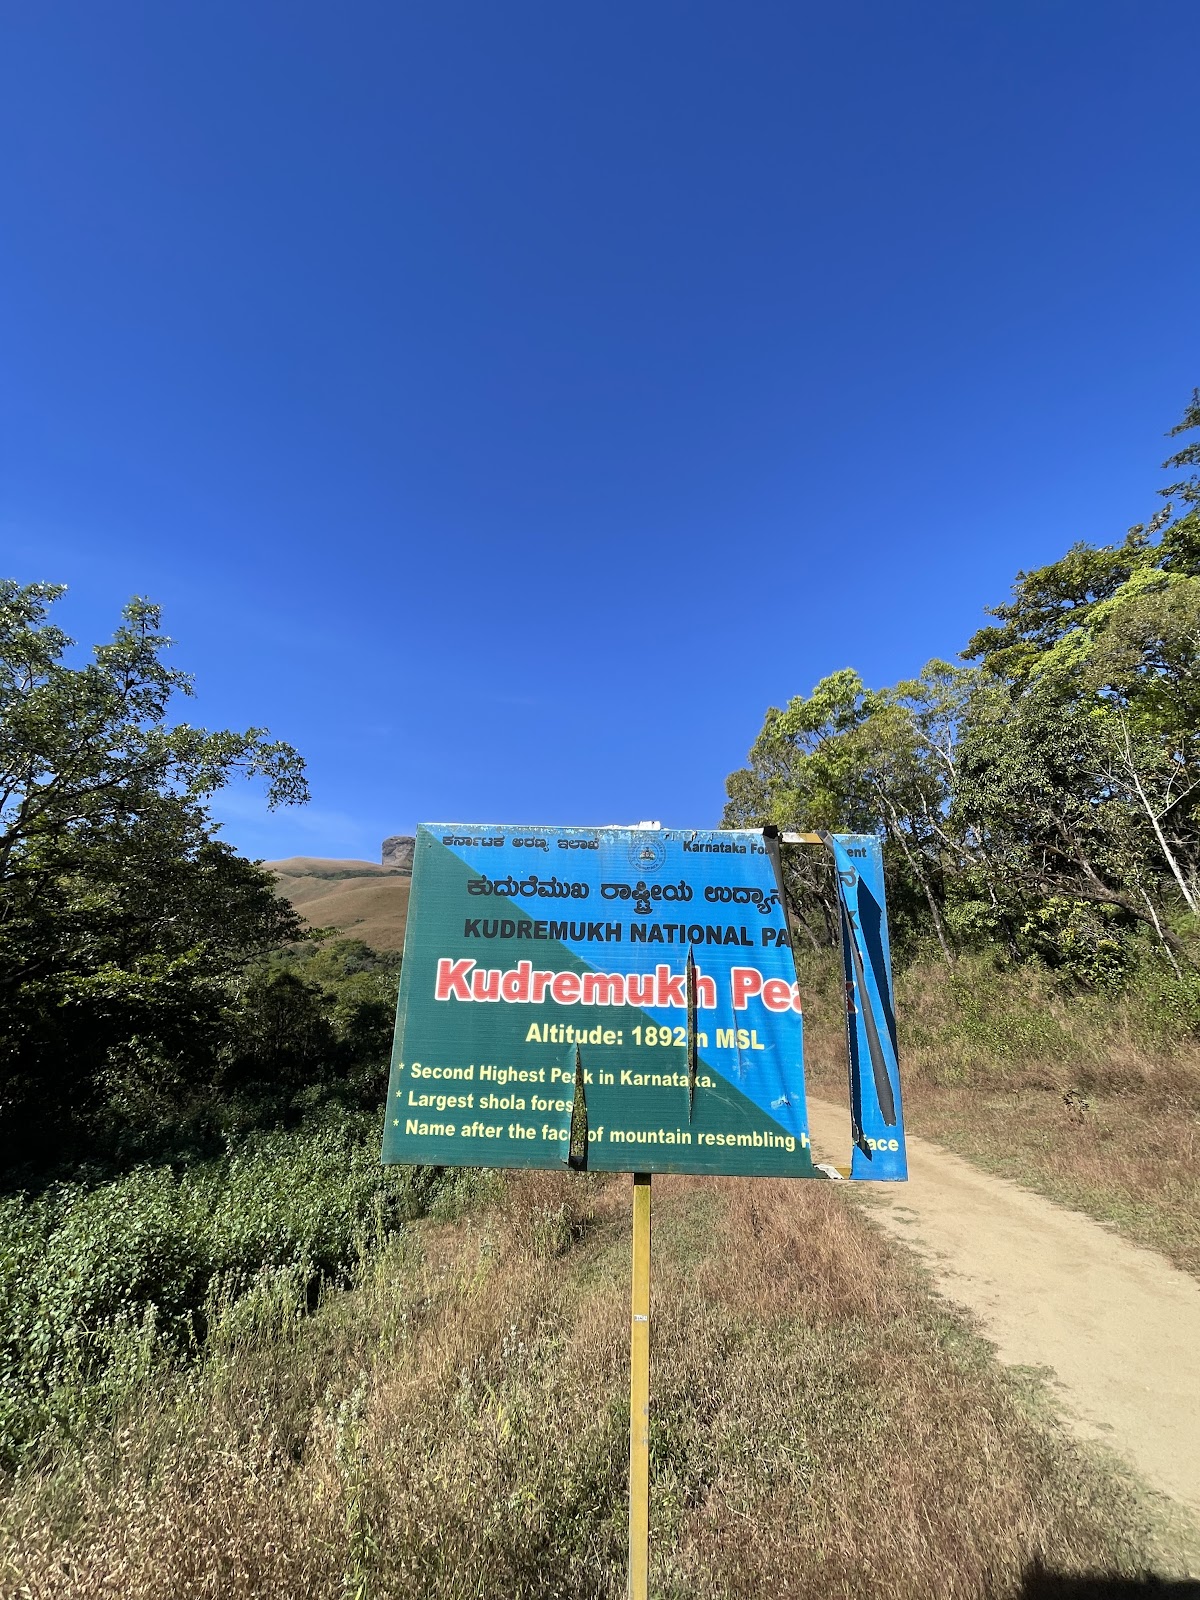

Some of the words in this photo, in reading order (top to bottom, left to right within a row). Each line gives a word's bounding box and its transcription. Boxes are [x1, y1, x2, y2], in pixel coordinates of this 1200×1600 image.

[683, 841, 747, 855] Karnataka
[467, 874, 590, 898] ಕುದುರೆಮುಖ
[600, 880, 693, 914] ರಾಷ್ಟ್ರೀಯ
[464, 919, 622, 942] KUDREMUKH
[630, 923, 754, 947] NATIONAL
[435, 958, 717, 1009] Kudremukh
[525, 1022, 623, 1045] Altitude:
[632, 1026, 686, 1047] 1892
[716, 1029, 765, 1050] MSL
[411, 1063, 474, 1081] Second
[480, 1065, 545, 1085] Highest
[600, 1070, 614, 1084] in
[408, 1090, 474, 1111] Largest
[479, 1094, 525, 1110] shola
[405, 1119, 456, 1136] Name
[461, 1122, 503, 1138] after
[508, 1124, 536, 1140] the
[542, 1125, 571, 1141] fac
[588, 1126, 604, 1142] of
[610, 1129, 692, 1145] mountain
[698, 1131, 795, 1152] resembling
